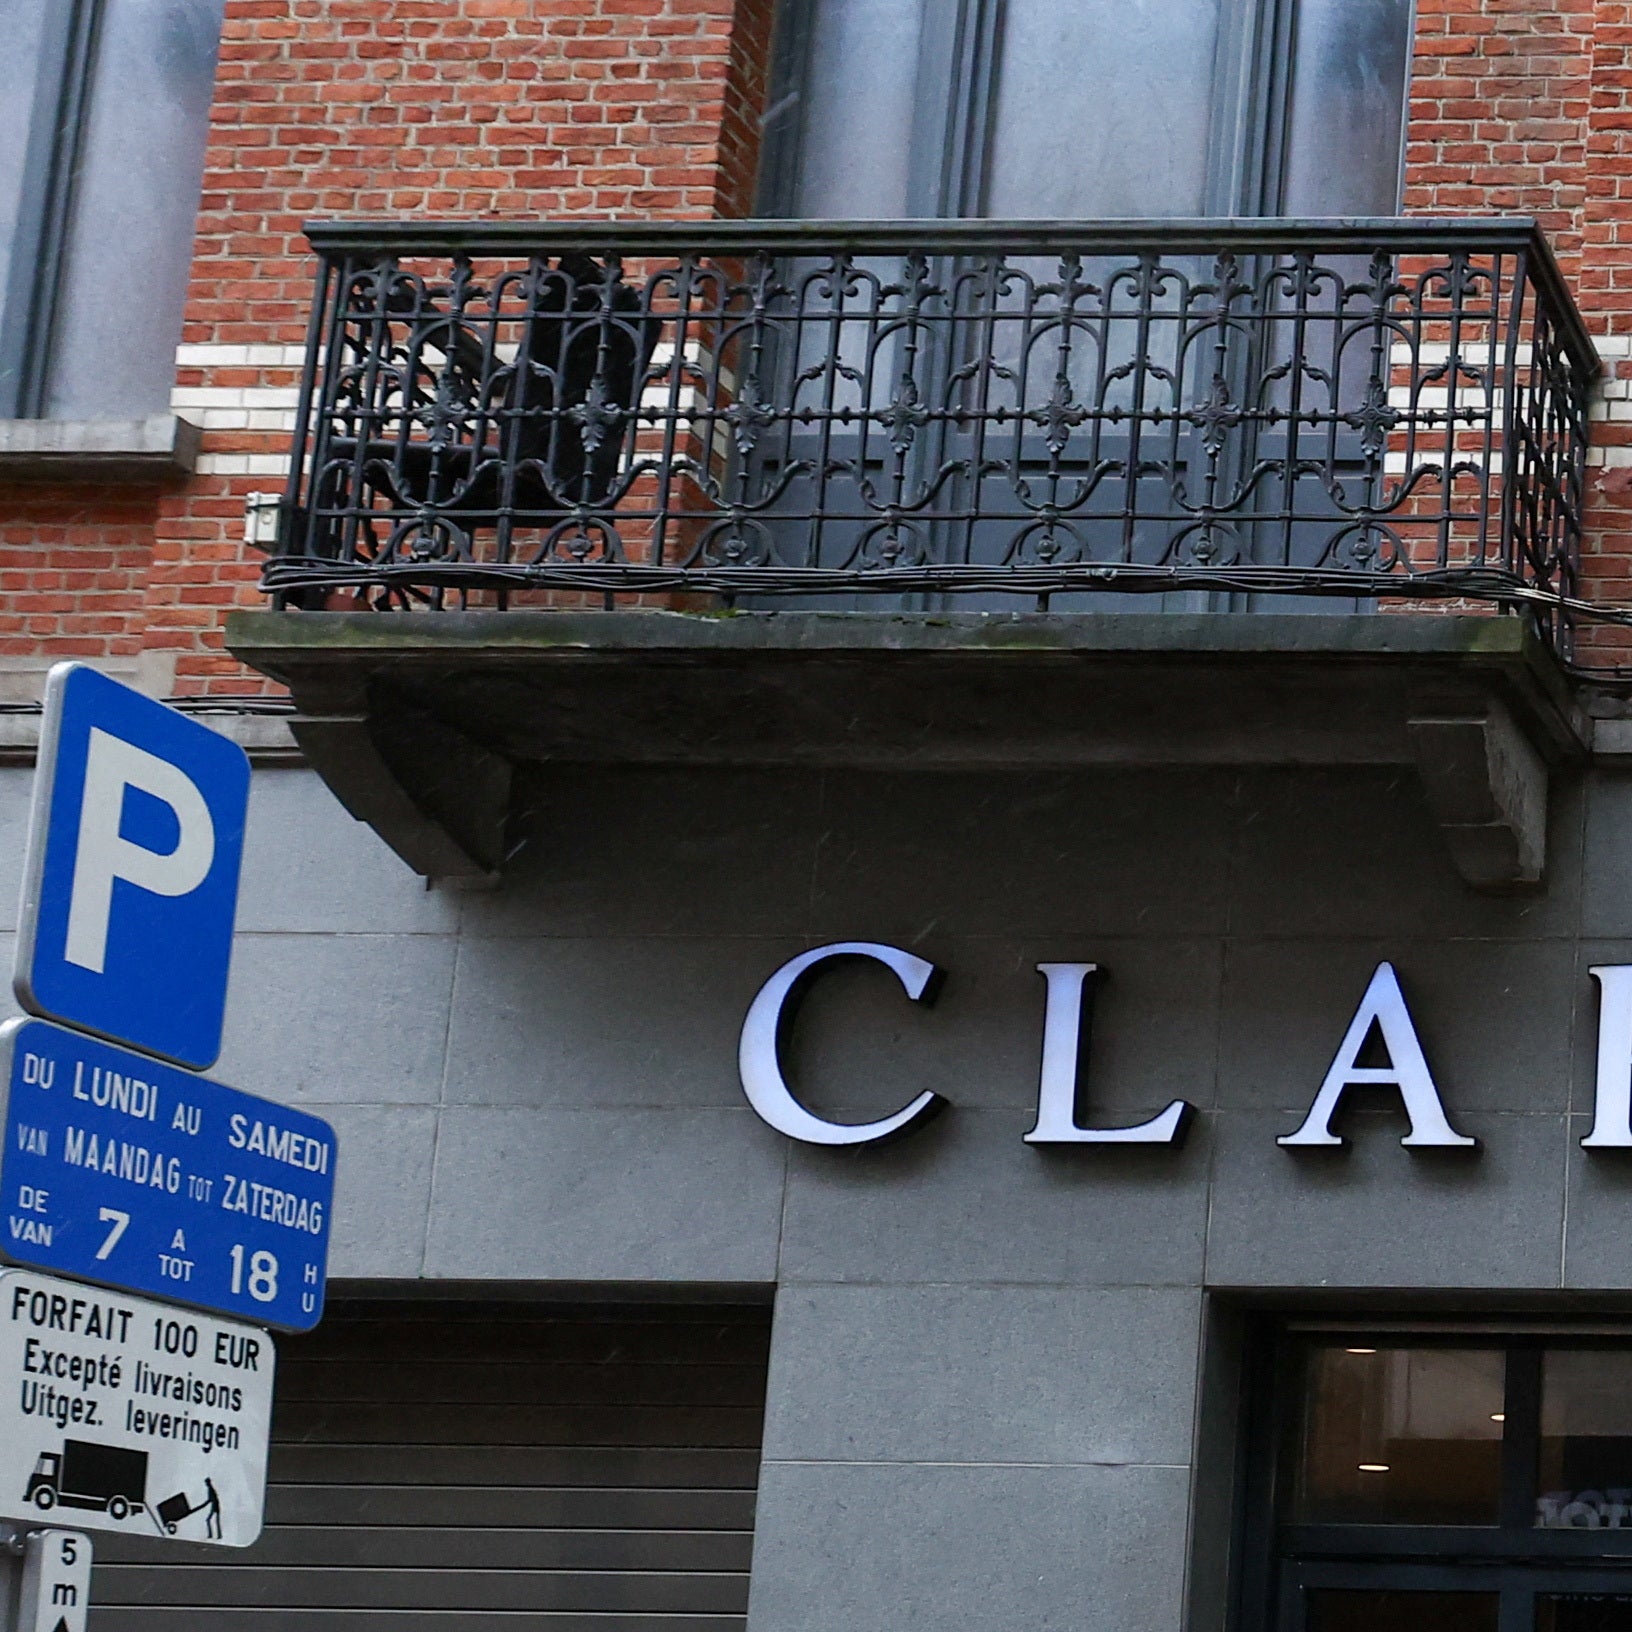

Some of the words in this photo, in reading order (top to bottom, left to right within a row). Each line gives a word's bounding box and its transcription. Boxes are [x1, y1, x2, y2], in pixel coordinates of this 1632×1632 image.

[64, 726, 214, 973] P
[23, 1053, 55, 1089] DU
[73, 1061, 157, 1121] LUNDI
[172, 1102, 201, 1135] AU
[229, 1113, 329, 1174] SAMEDI
[17, 1123, 48, 1156] VAN
[64, 1126, 181, 1194] MAANDAG
[188, 1175, 213, 1203] TOT
[221, 1174, 323, 1235] ZATERDAG
[19, 1185, 49, 1214] DE
[9, 1216, 53, 1247] VAN
[95, 1207, 130, 1260] 7
[170, 1229, 186, 1252] A
[158, 1254, 195, 1282] TOT
[230, 1244, 278, 1303] 18
[305, 1263, 317, 1285] H
[302, 1292, 314, 1313] U
[12, 1286, 133, 1343] FORFAIT
[154, 1318, 198, 1358] 100
[214, 1332, 260, 1371] EUR
[24, 1338, 122, 1391] Excepté
[134, 1361, 243, 1412] livraisons
[21, 1380, 103, 1429] Uitgez.
[126, 1400, 239, 1453] leveringen
[61, 1538, 77, 1566] 5
[52, 1582, 77, 1607] m
